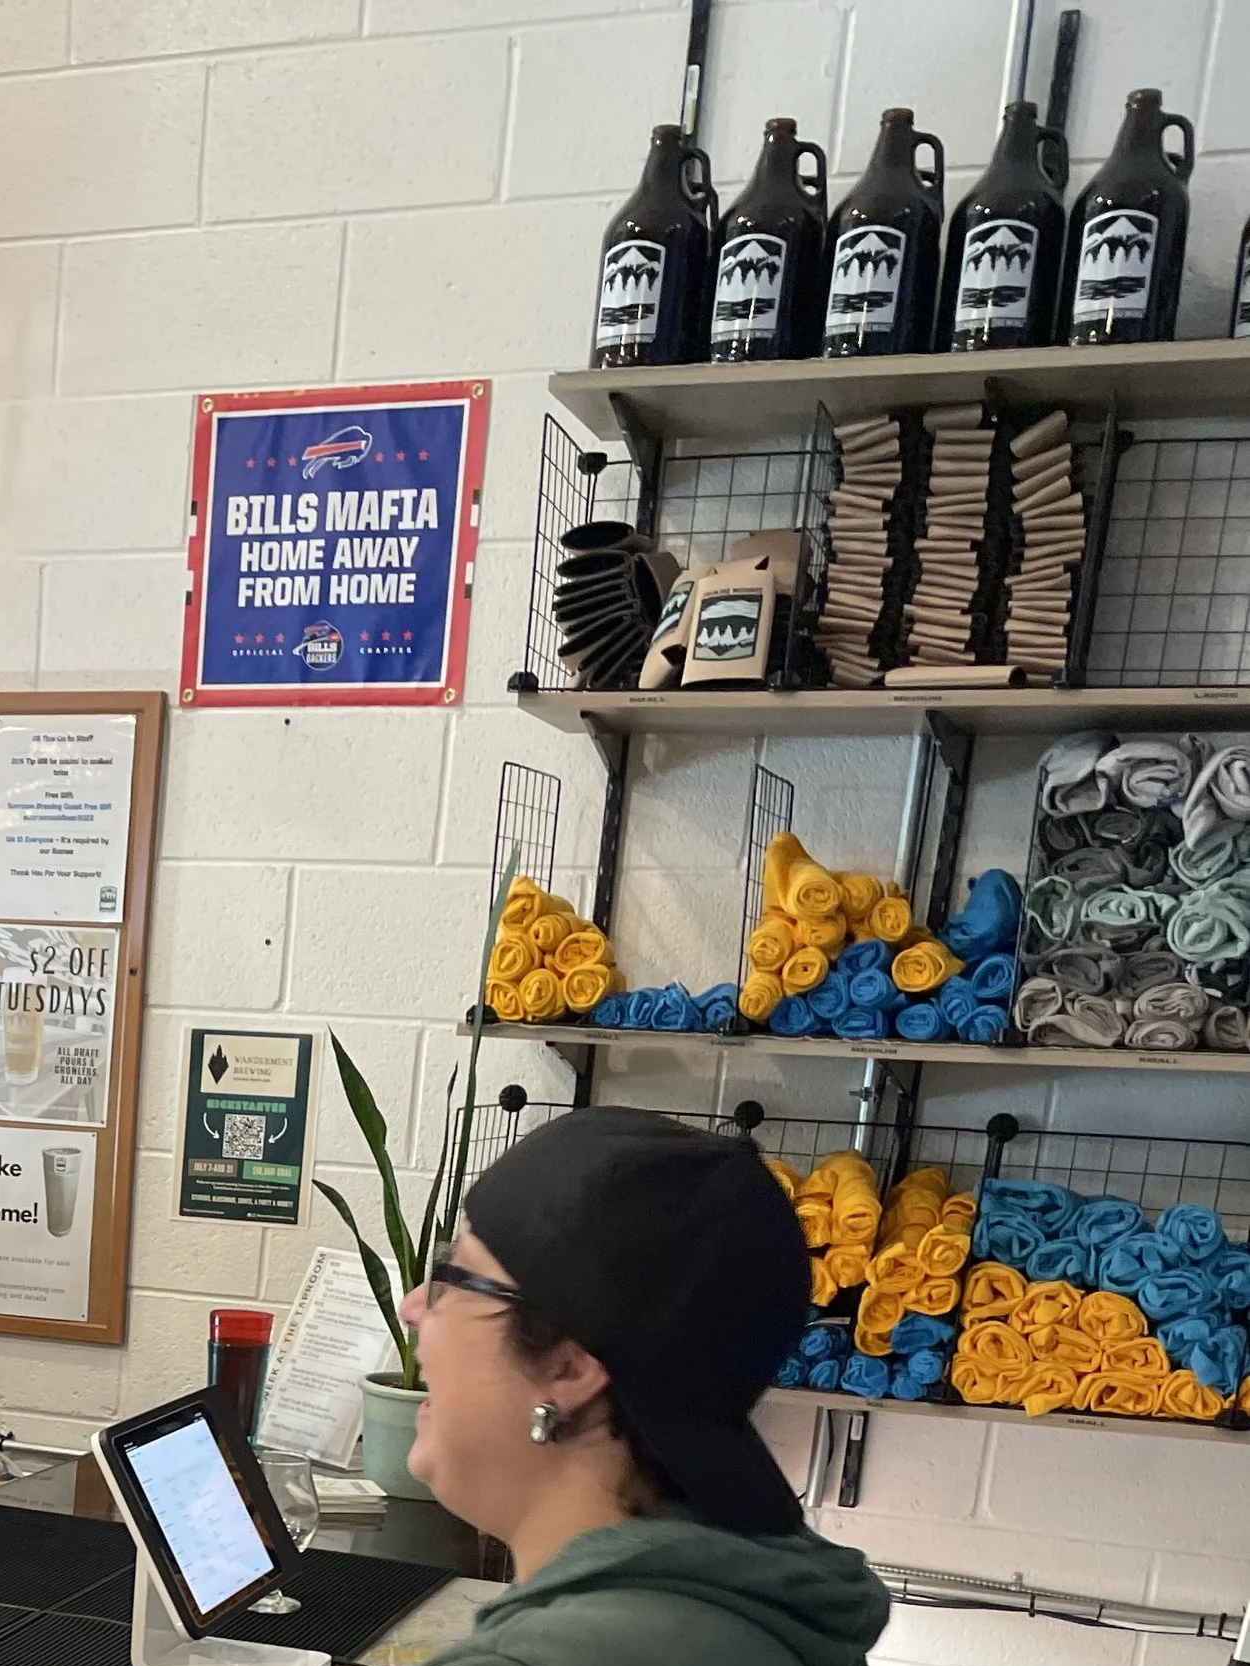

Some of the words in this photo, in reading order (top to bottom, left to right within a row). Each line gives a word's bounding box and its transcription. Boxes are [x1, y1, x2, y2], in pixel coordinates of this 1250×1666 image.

[226, 492, 319, 536] BILLS
[325, 488, 439, 532] MAFIA
[239, 539, 326, 572] HOME
[332, 536, 420, 569] AWAY
[238, 575, 321, 608] FROM
[329, 573, 417, 605] HOME
[232, 648, 284, 657] OFFICIAL
[359, 646, 413, 655] CHAPTER
[307, 642, 338, 653] BILLS
[30, 945, 56, 977] $2
[69, 946, 110, 978] OFF
[57, 1046, 72, 1057] ALL
[73, 1047, 99, 1058] DRAFT
[59, 1056, 87, 1067] POURS
[60, 1076, 74, 1085] ALL
[76, 1077, 92, 1086] DAY
[276, 1348, 288, 1364] AT
[283, 1319, 301, 1344] THE
[294, 1253, 327, 1317] TAPROOM
